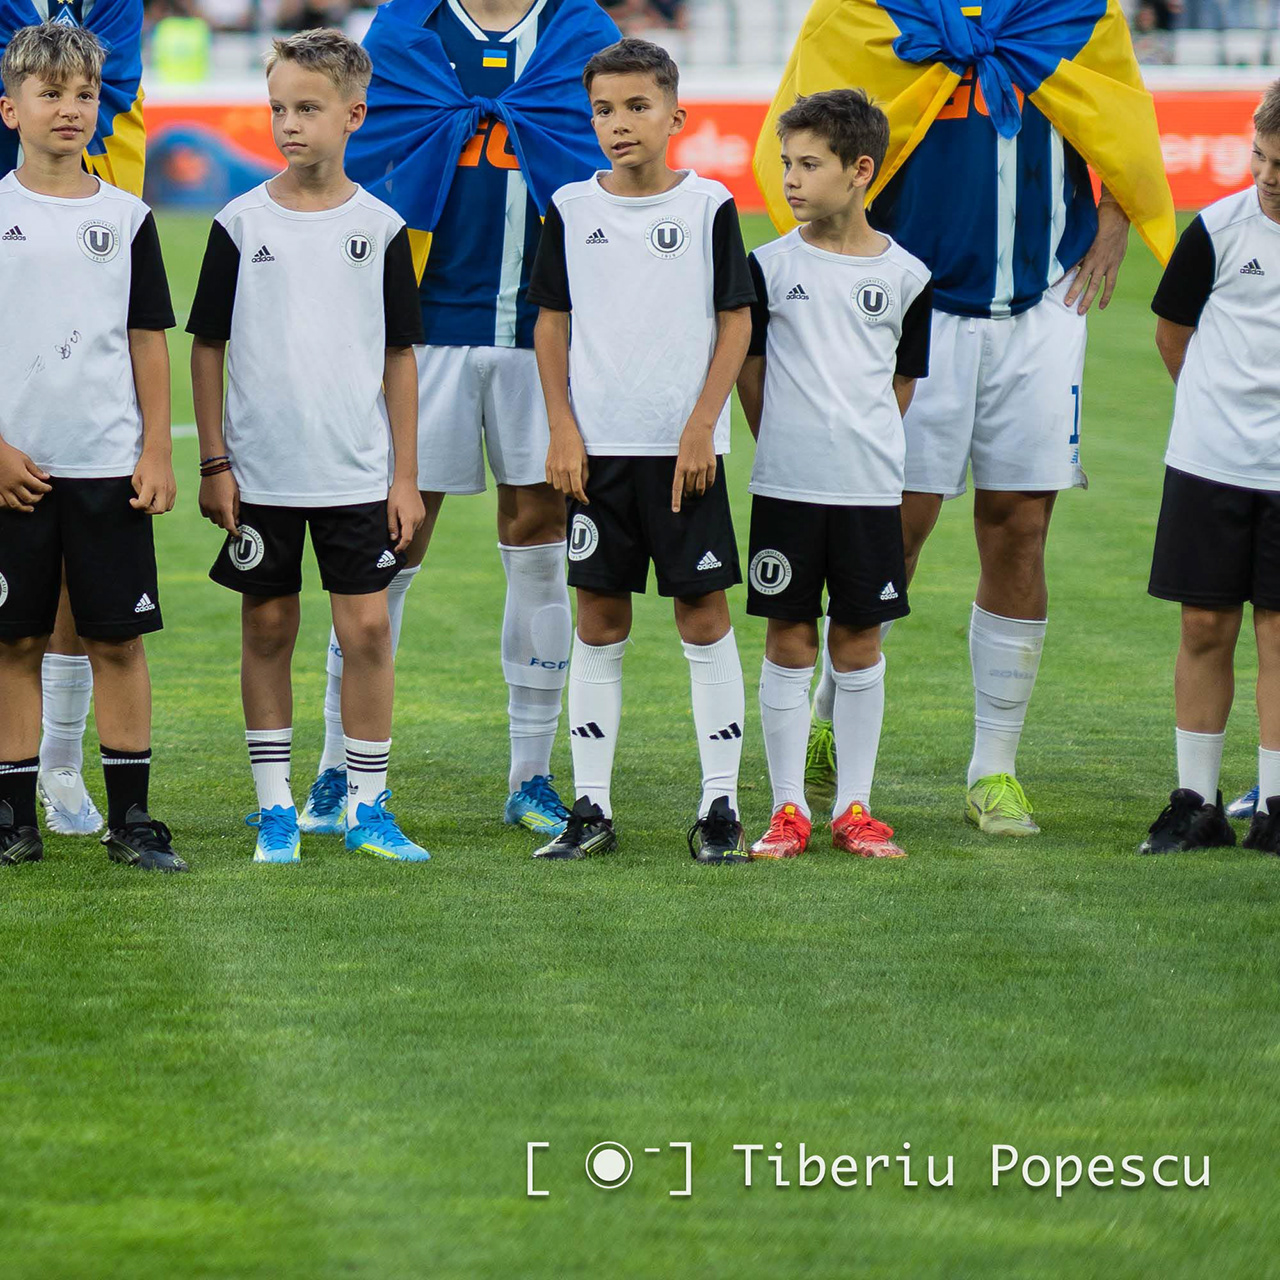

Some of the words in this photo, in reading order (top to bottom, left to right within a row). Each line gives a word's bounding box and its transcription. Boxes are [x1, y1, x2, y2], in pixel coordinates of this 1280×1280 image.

[89, 230, 110, 252] U
[657, 228, 677, 249] U
[251, 255, 275, 263] adidas
[350, 240, 367, 259] U
[1240, 268, 1265, 276] adidas
[863, 290, 884, 312] U
[760, 561, 780, 585] U
